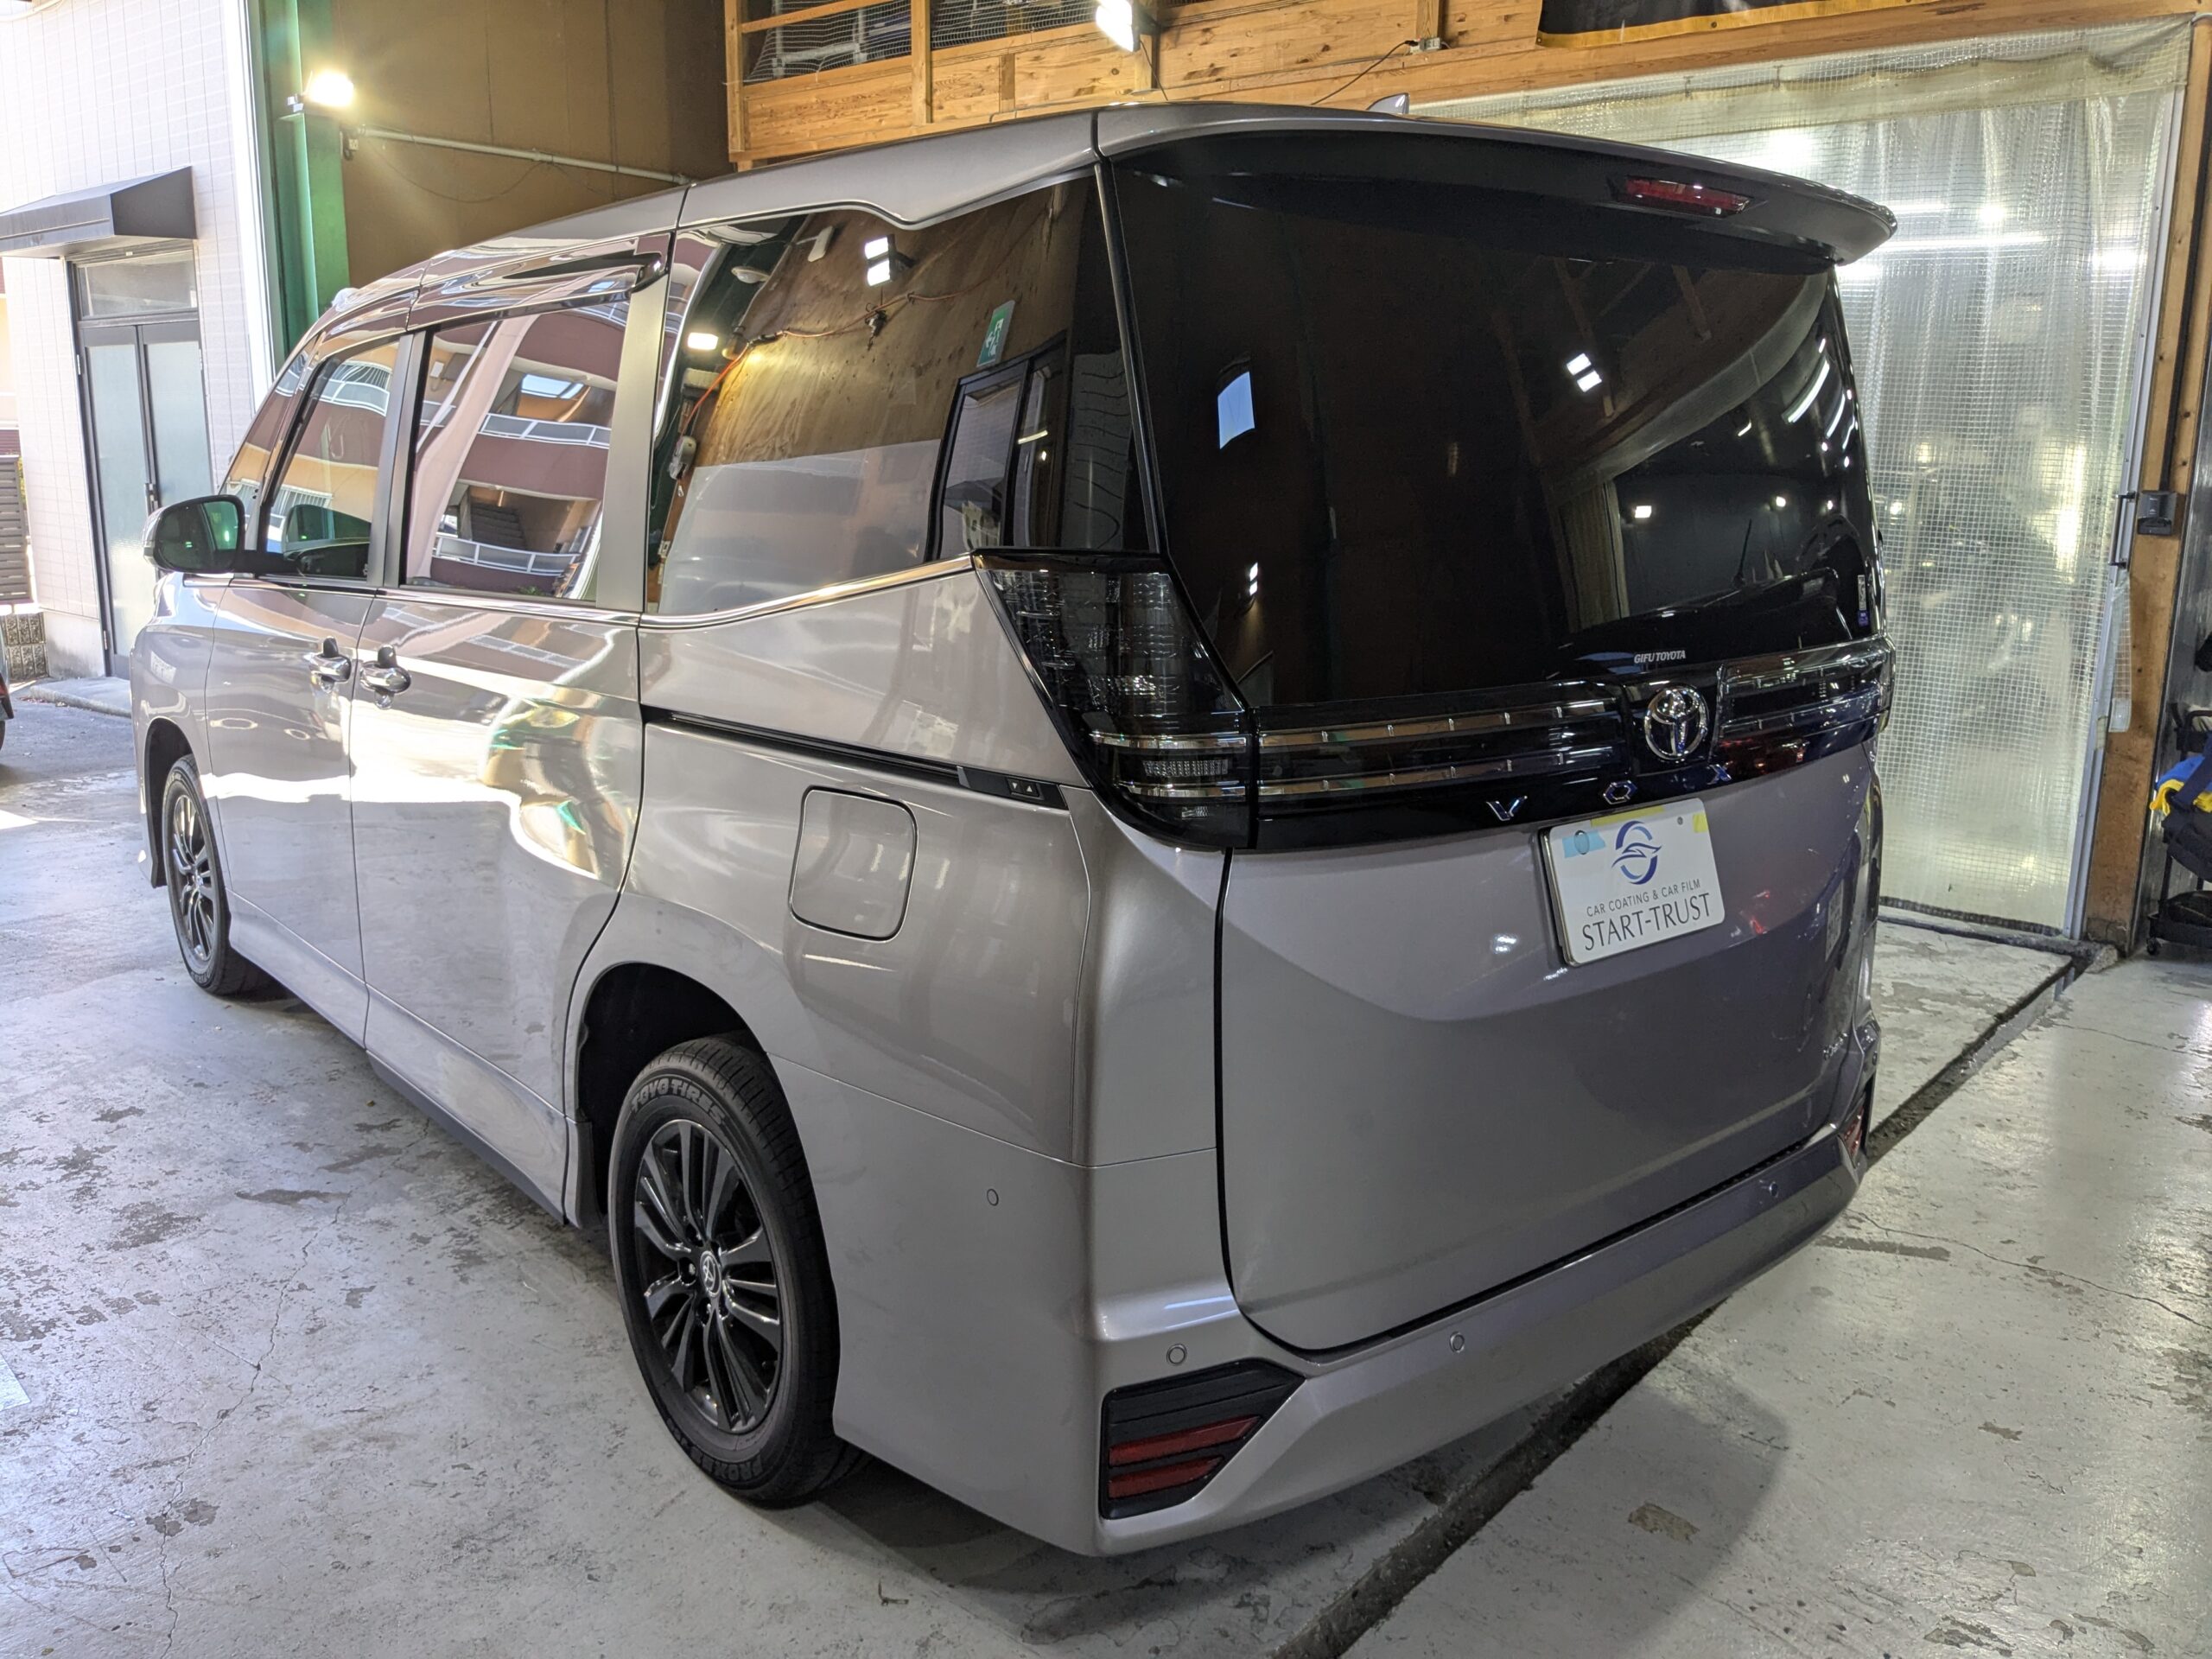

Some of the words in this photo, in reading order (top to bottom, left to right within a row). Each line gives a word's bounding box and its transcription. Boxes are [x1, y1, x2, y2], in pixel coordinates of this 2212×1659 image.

[1634, 653, 1655, 664] GIFU
[1655, 650, 1687, 662] TOYOTA
[1586, 903, 1606, 917] CAR
[1608, 892, 1649, 912] COATING
[1652, 889, 1659, 900] &
[1661, 884, 1679, 898] CAR
[1681, 879, 1700, 893] FILM
[1582, 893, 1710, 951] START-TRUST
[632, 1077, 670, 1113] TOYO
[671, 1078, 726, 1124] TIRES
